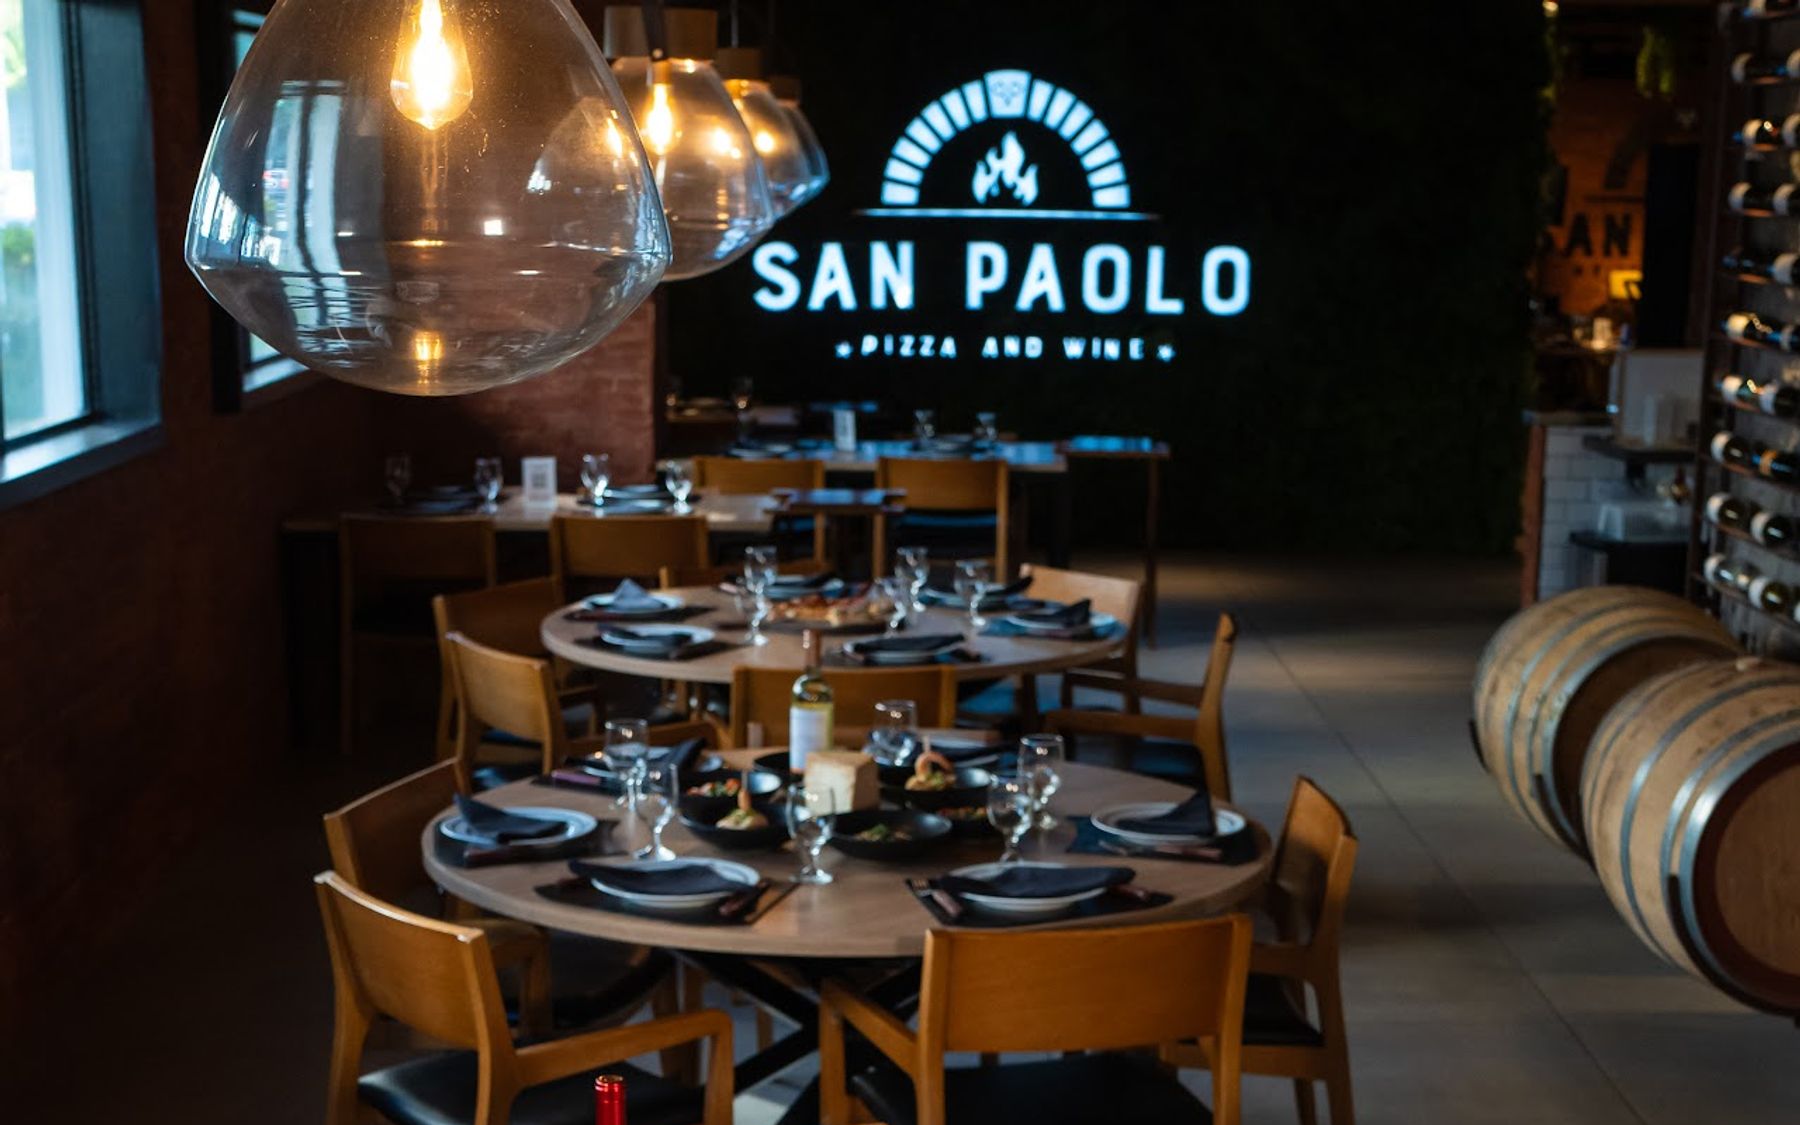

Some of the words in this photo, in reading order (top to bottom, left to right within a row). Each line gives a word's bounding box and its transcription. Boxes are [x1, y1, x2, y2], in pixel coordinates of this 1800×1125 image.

[1545, 213, 1632, 257] AN
[752, 241, 915, 312] SAN
[966, 242, 1251, 316] PAOLO
[861, 335, 957, 358] PIZZA
[982, 336, 1043, 359] AND
[1063, 337, 1145, 360] WINE
